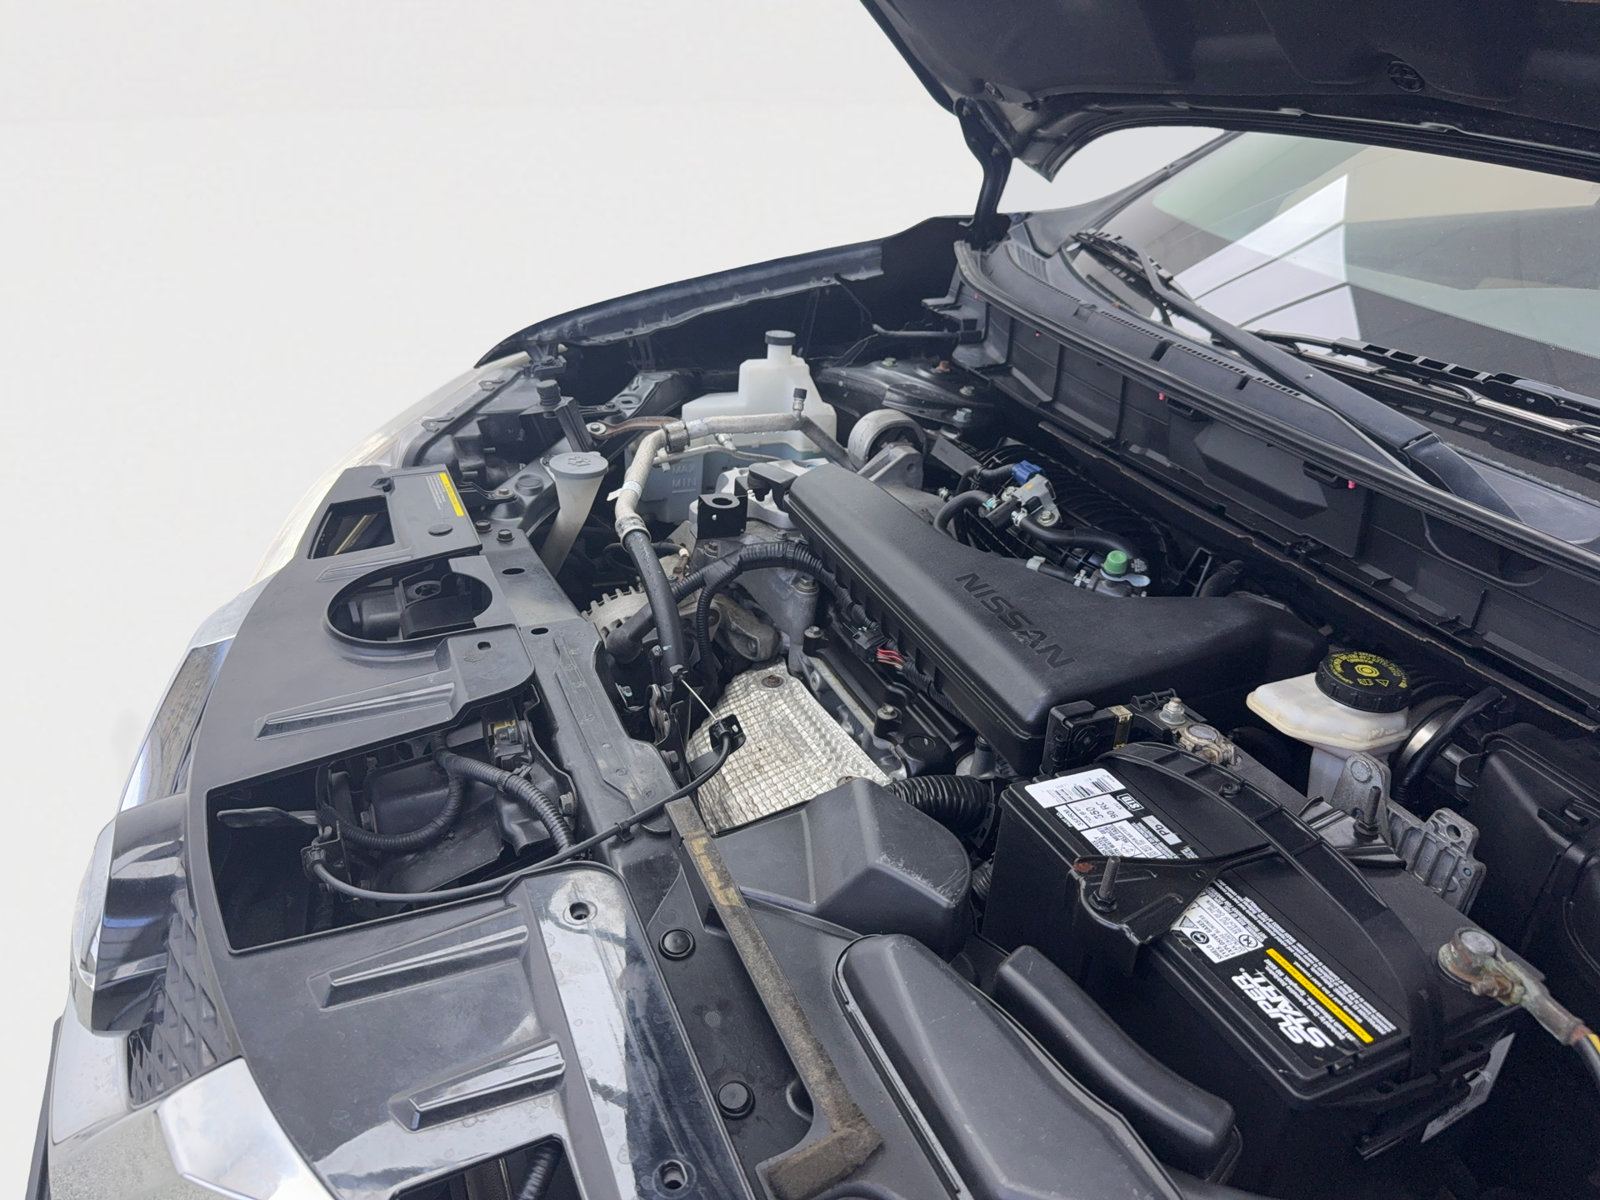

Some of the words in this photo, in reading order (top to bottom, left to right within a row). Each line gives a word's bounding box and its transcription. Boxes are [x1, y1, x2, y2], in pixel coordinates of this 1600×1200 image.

[955, 572, 1076, 669] NISSAN
[1154, 824, 1169, 835] Pb
[1231, 974, 1306, 1043] SUPER
[1243, 971, 1335, 1047] START
